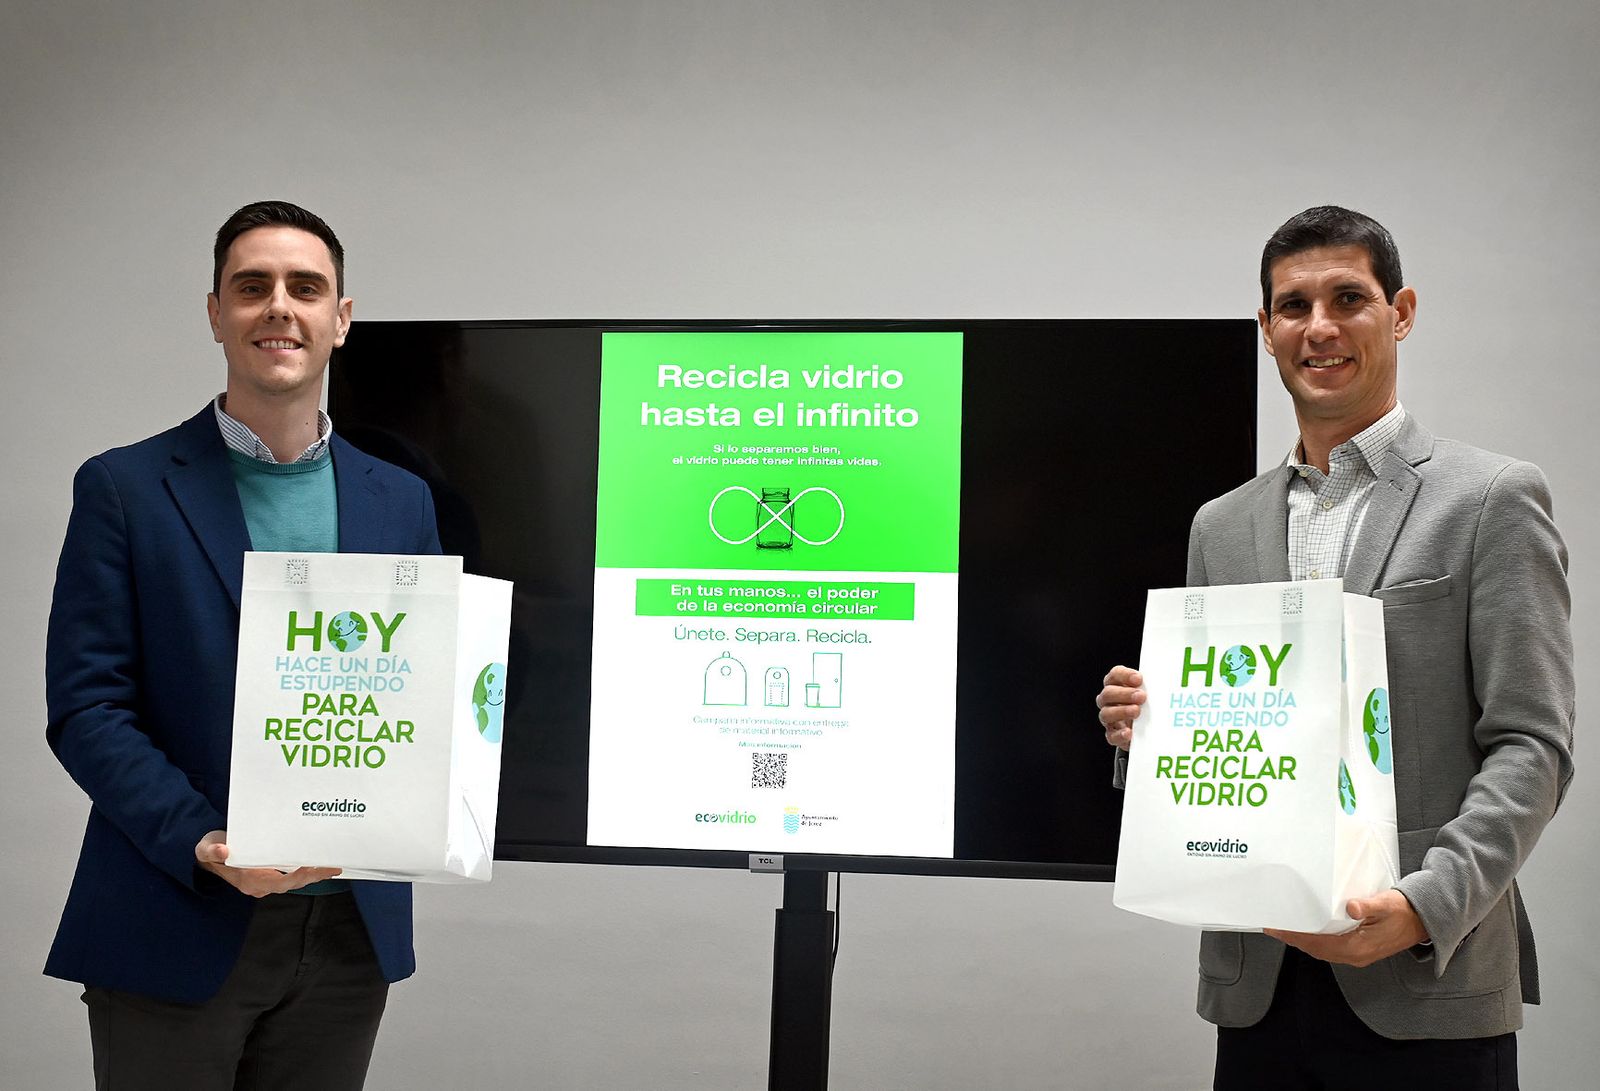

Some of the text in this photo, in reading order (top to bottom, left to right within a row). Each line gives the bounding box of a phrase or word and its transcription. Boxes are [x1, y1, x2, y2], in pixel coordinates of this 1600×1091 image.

[657, 364, 904, 388] Recicla vidrio
[640, 402, 920, 428] hasta el infinito
[713, 444, 841, 456] Si lo separamos bien,
[672, 456, 882, 466] el vidrio puede tener infinitas vidas.
[670, 584, 879, 601] En tus manos... el poder
[676, 599, 878, 614] de la economía circular
[286, 610, 407, 652] HOY
[674, 624, 872, 645] Únete. Separa. Recicla.
[275, 655, 412, 674] HACE UN DÍA
[1180, 644, 1293, 688] HOY
[280, 674, 404, 692] ESTUPENDO
[302, 692, 380, 716] PARA
[1170, 688, 1297, 708] HACE UN DÍA
[1173, 710, 1288, 727] ESTUPENDO
[264, 718, 415, 744] RECICLAR
[1192, 729, 1264, 752] PARA
[281, 744, 386, 769] VIDRIO
[1156, 756, 1297, 780] RECICLAR
[302, 798, 366, 812] ecovidrio
[1170, 782, 1268, 808] VIDRIO
[695, 810, 756, 824] ecovidrio
[1186, 838, 1248, 853] ecovidrio
